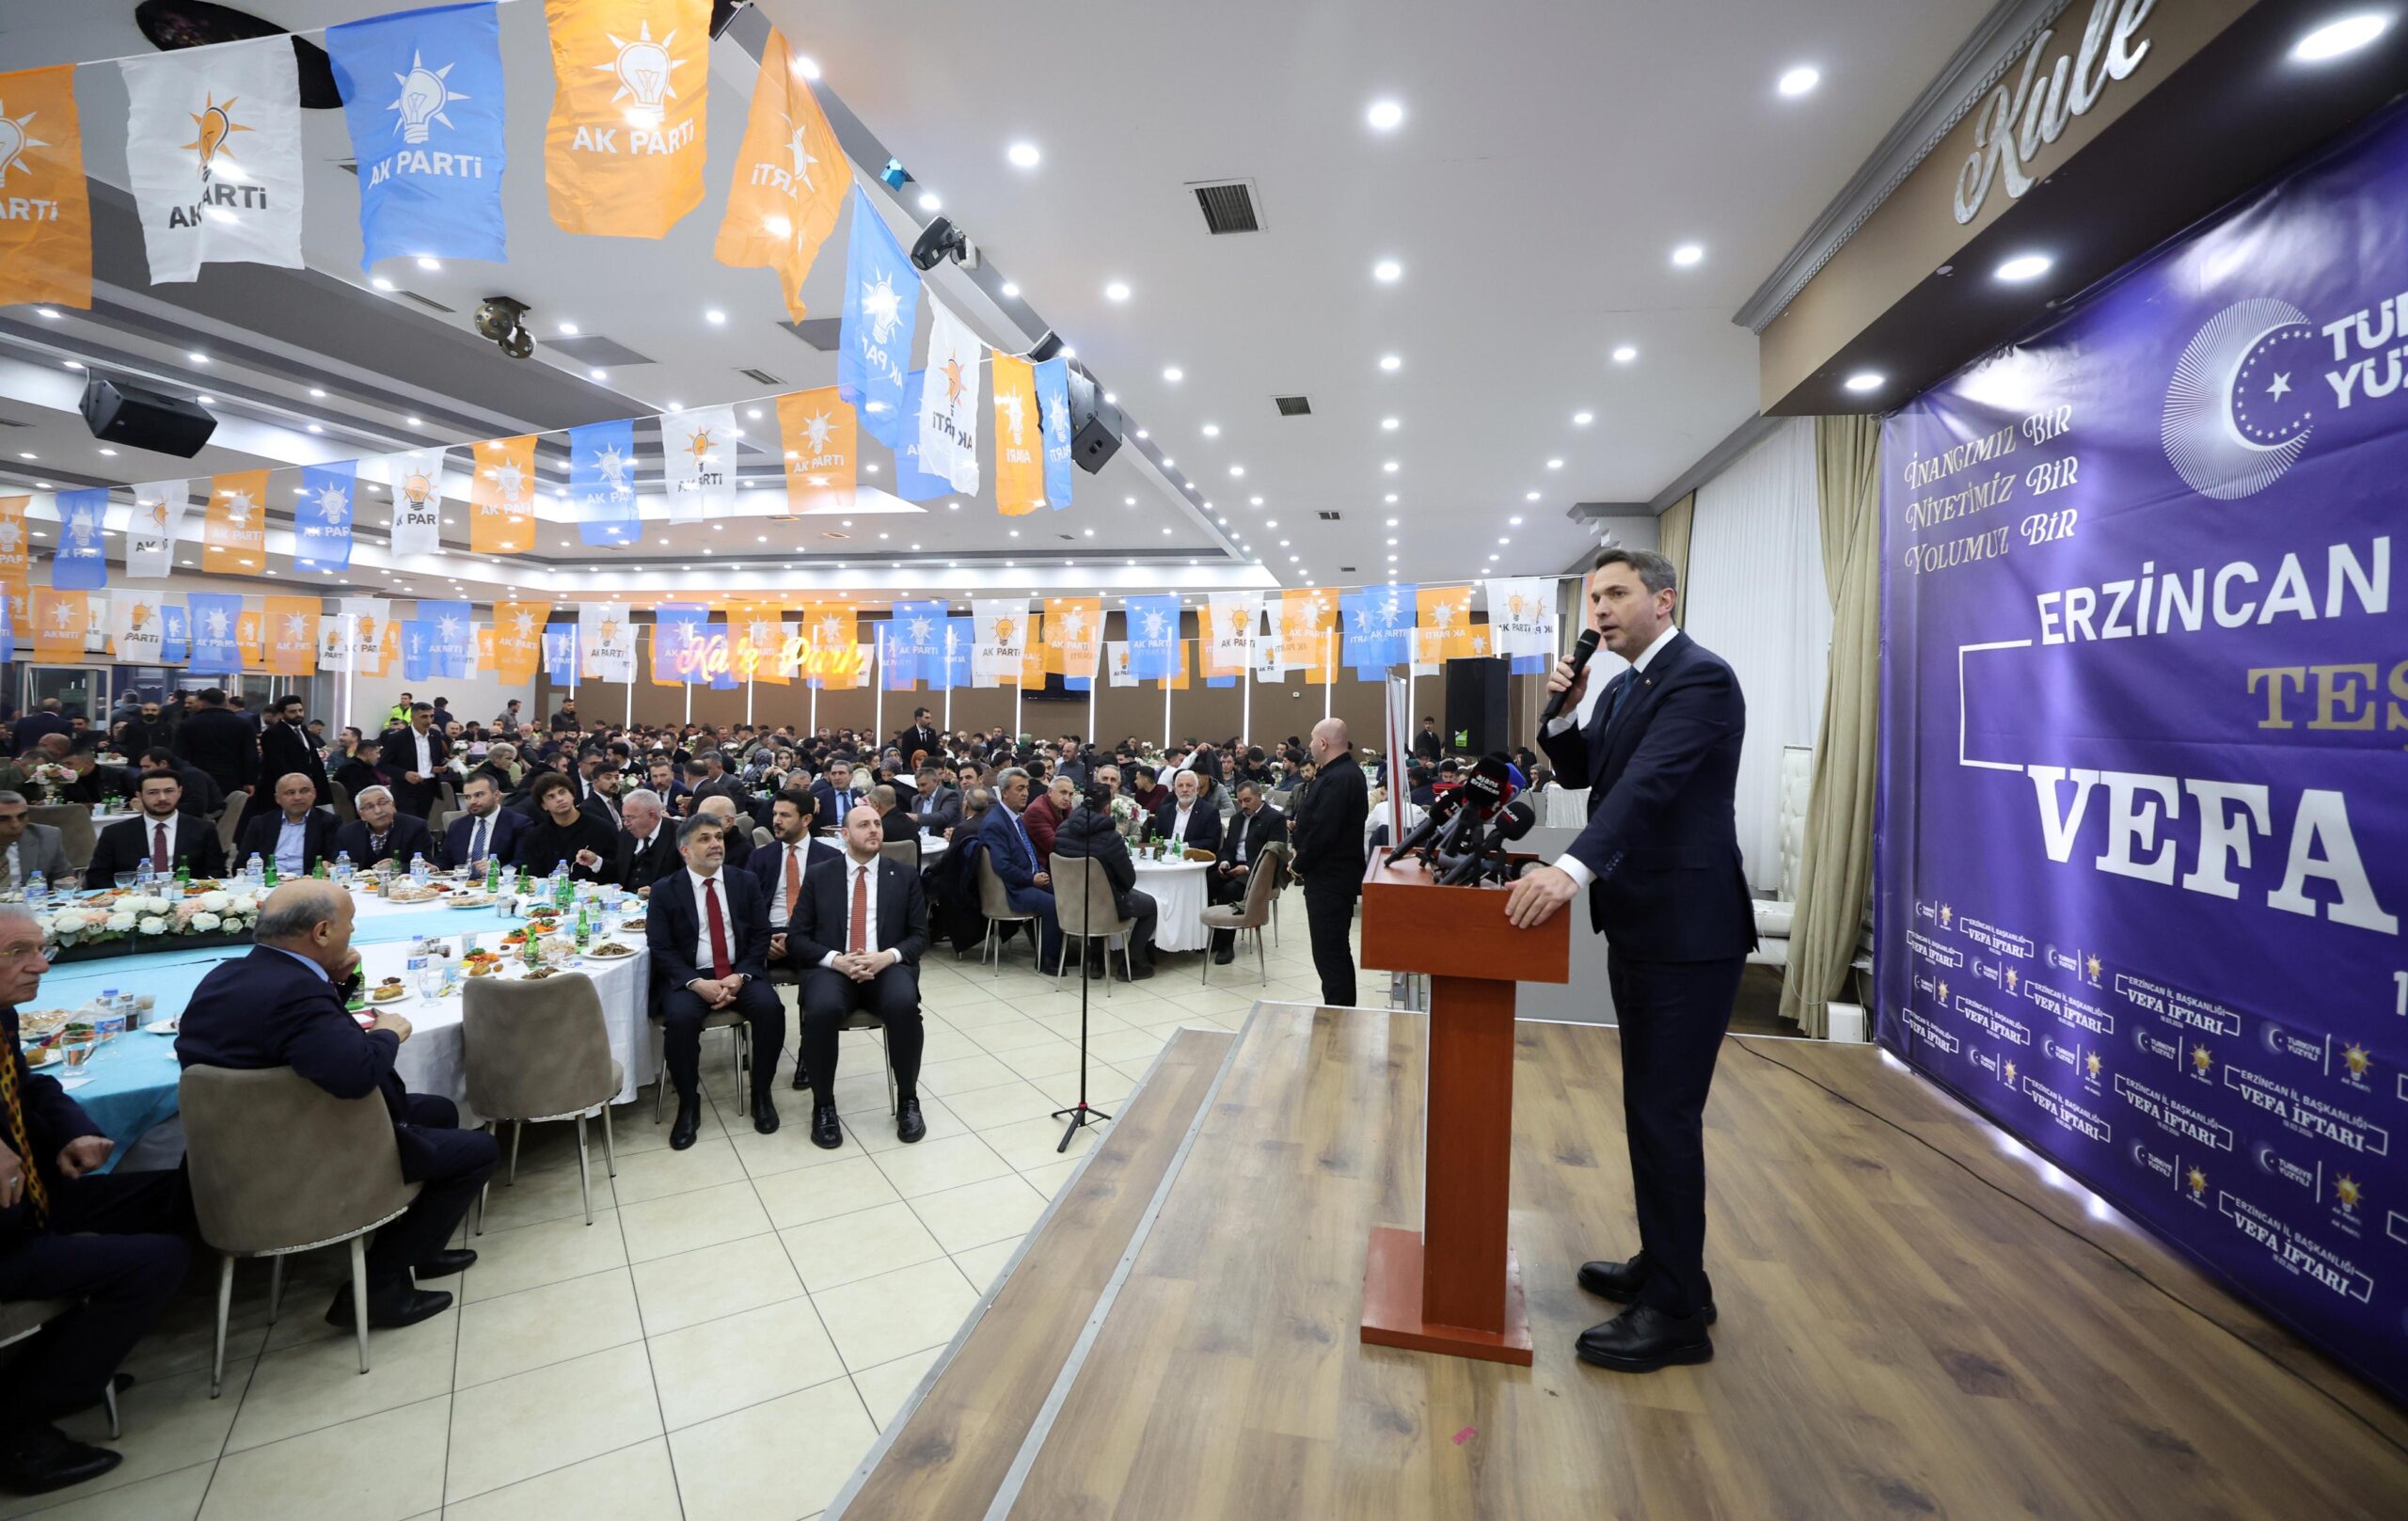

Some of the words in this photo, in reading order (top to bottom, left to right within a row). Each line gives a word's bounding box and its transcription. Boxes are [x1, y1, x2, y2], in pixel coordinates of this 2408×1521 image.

[1954, 0, 2153, 225] Kule
[572, 126, 617, 154] AK
[368, 157, 390, 190] AK
[2022, 404, 2072, 446] BİR
[2025, 456, 2078, 496] BİR
[1905, 526, 2009, 575] YOLUMUZ
[2020, 508, 2078, 546] BİR
[2036, 535, 2390, 645] ERZİNCAN
[2027, 765, 2399, 936] VEFA
[1968, 927, 1991, 945] VEFA
[1964, 1007, 1988, 1028] VEFA
[2034, 992, 2061, 1015] VEFA
[2063, 1003, 2102, 1034] İFTARI
[2127, 988, 2164, 1014] VEFA
[2167, 999, 2224, 1036] İFTARI
[2032, 1089, 2058, 1116] VEFA
[2060, 1103, 2099, 1141] İFTARI
[2126, 1089, 2161, 1119] VEFA
[2163, 1106, 2217, 1149] İFTARI
[2240, 1083, 2288, 1117] VEFA
[2292, 1101, 2366, 1152] İFTARI
[2241, 1069, 2289, 1098] ERZİNCAN
[2303, 1095, 2368, 1131] BAŞKANLIĞI
[2235, 1197, 2281, 1231] ERZİNCAN
[2234, 1211, 2279, 1252] VEFA
[2282, 1238, 2350, 1297] İFTARI
